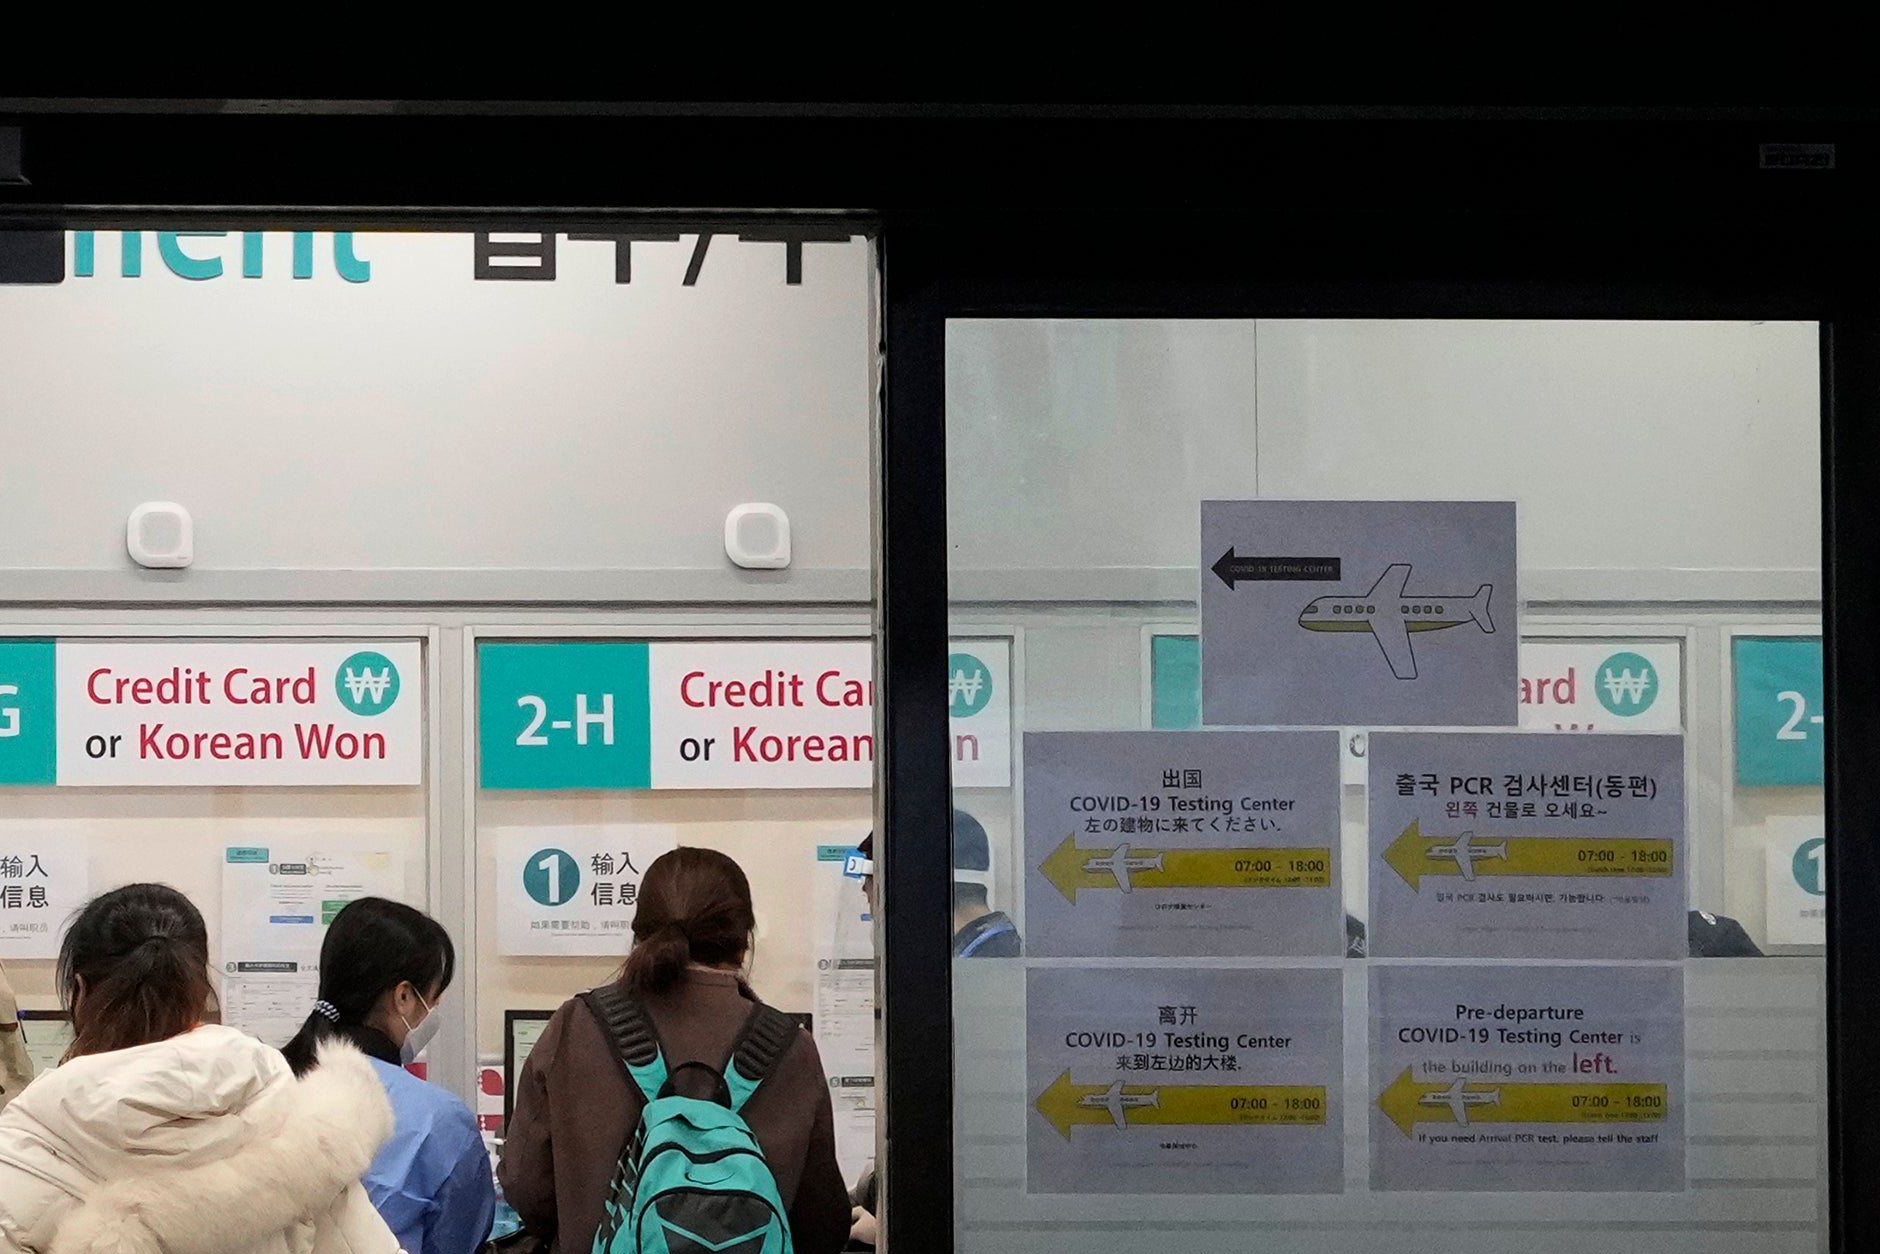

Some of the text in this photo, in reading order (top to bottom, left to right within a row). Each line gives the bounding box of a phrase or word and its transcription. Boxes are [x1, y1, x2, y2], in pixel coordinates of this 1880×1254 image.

[87, 667, 211, 705] Credit
[223, 667, 315, 705] Card
[681, 670, 803, 708] Credit
[516, 694, 615, 747] 2-H
[85, 724, 385, 760] or Korean Won
[679, 726, 874, 763] or Korean
[1162, 768, 1202, 789] 出国
[1395, 773, 1657, 800] 출국 PCR 검사센터(동편)
[1070, 796, 1295, 815] COVID-19 Testing Center
[1445, 801, 1479, 819] 왼쪽
[1486, 801, 1537, 819] 건물로
[0, 854, 48, 879] 输入
[591, 851, 640, 876] 输入
[1235, 860, 1271, 872] 07:00
[1289, 860, 1324, 872] 18:00
[1578, 850, 1614, 863] 07:00
[1632, 850, 1667, 863] 18:00
[538, 855, 561, 904] 1
[0, 883, 49, 909] 信息
[591, 881, 637, 907] 信息
[1158, 1005, 1198, 1025] 离开
[1455, 1004, 1584, 1023] Pre-departure
[1066, 1032, 1291, 1052] COVID-19 Testing Center
[1398, 1028, 1641, 1047] COVID-19 Testing Center is
[1423, 1052, 1618, 1076] the building on the left.
[1231, 1097, 1267, 1110] 07:00
[1285, 1097, 1320, 1110] 18:00
[1572, 1096, 1609, 1108] 07:00
[1626, 1096, 1661, 1108] 18:00
[1429, 1135, 1449, 1144] you
[1452, 1134, 1475, 1143] need
[1515, 1134, 1534, 1143] PCR
[1563, 1134, 1594, 1145] please
[1598, 1134, 1613, 1143] tell
[1617, 1134, 1633, 1143] the
[1637, 1134, 1659, 1143] staff
